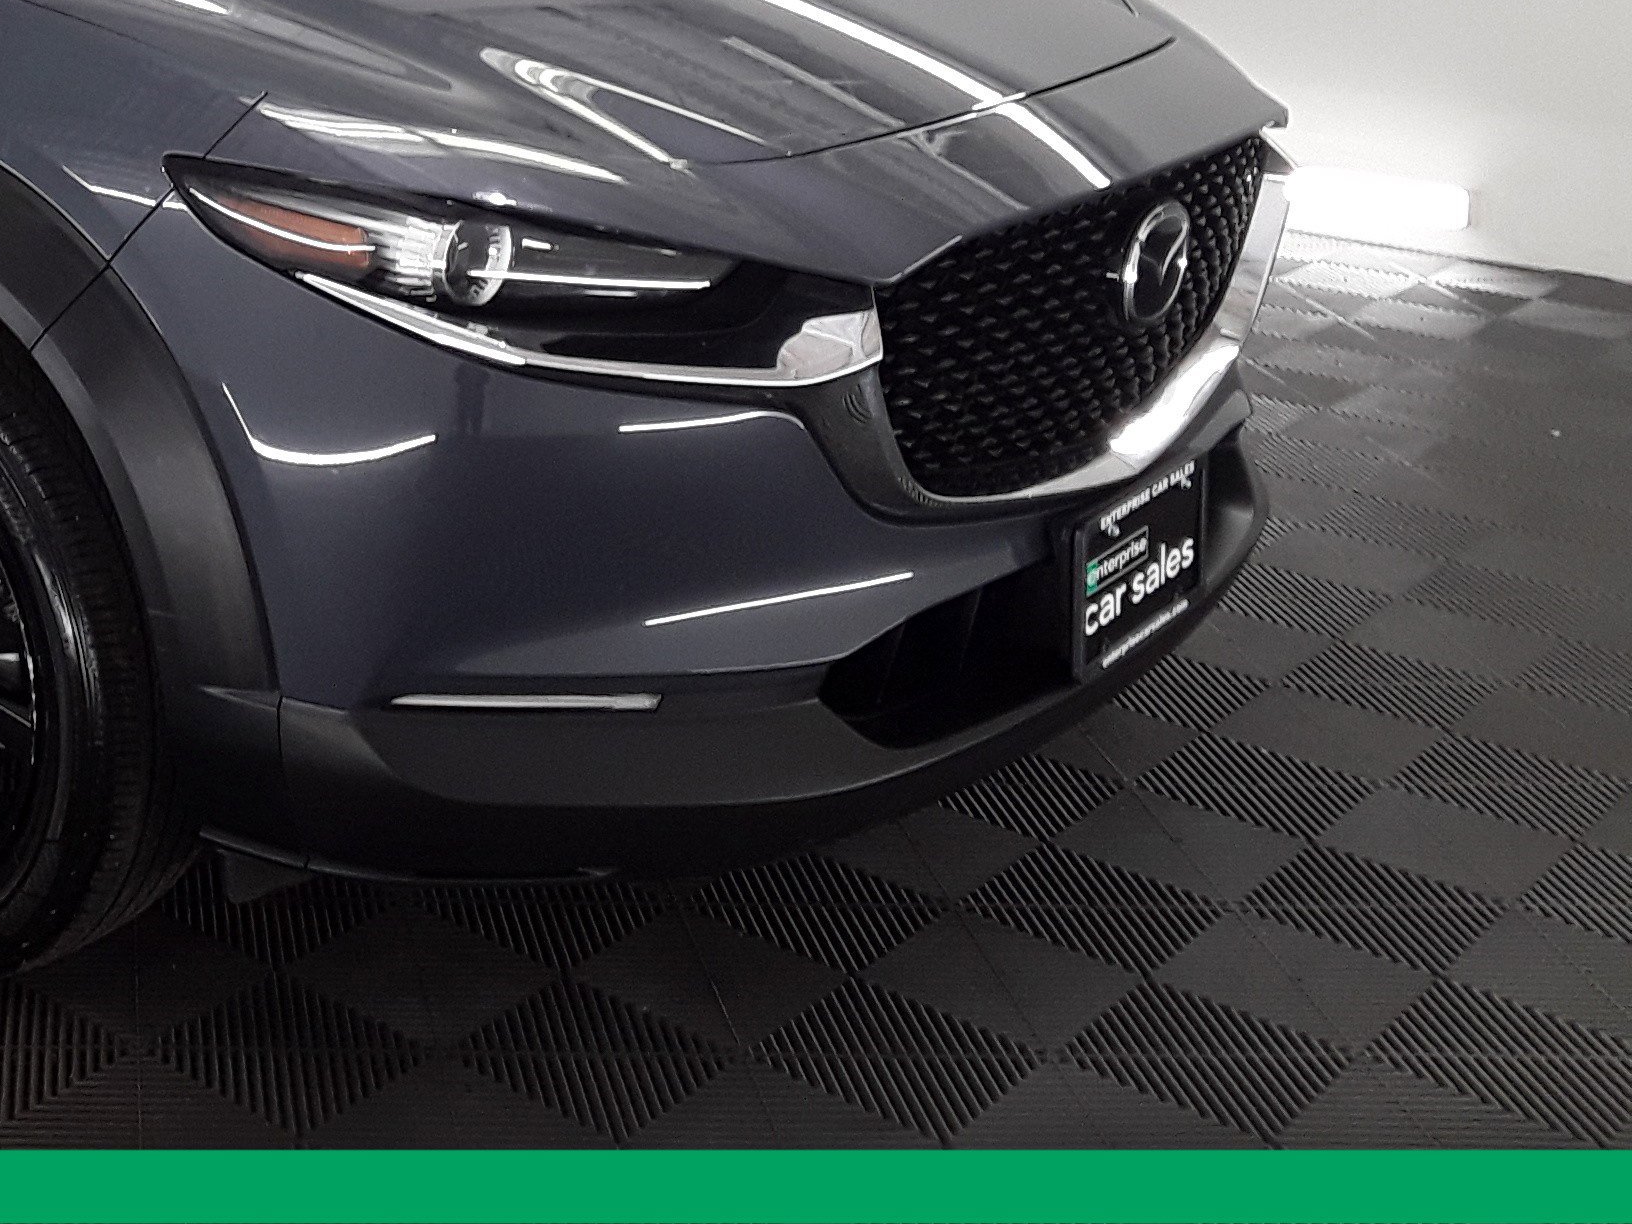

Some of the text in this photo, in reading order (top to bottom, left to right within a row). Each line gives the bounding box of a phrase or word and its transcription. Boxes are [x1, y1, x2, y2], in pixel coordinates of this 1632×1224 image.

[1085, 536, 1195, 637] car sales
[1086, 536, 1148, 588] enterprise
